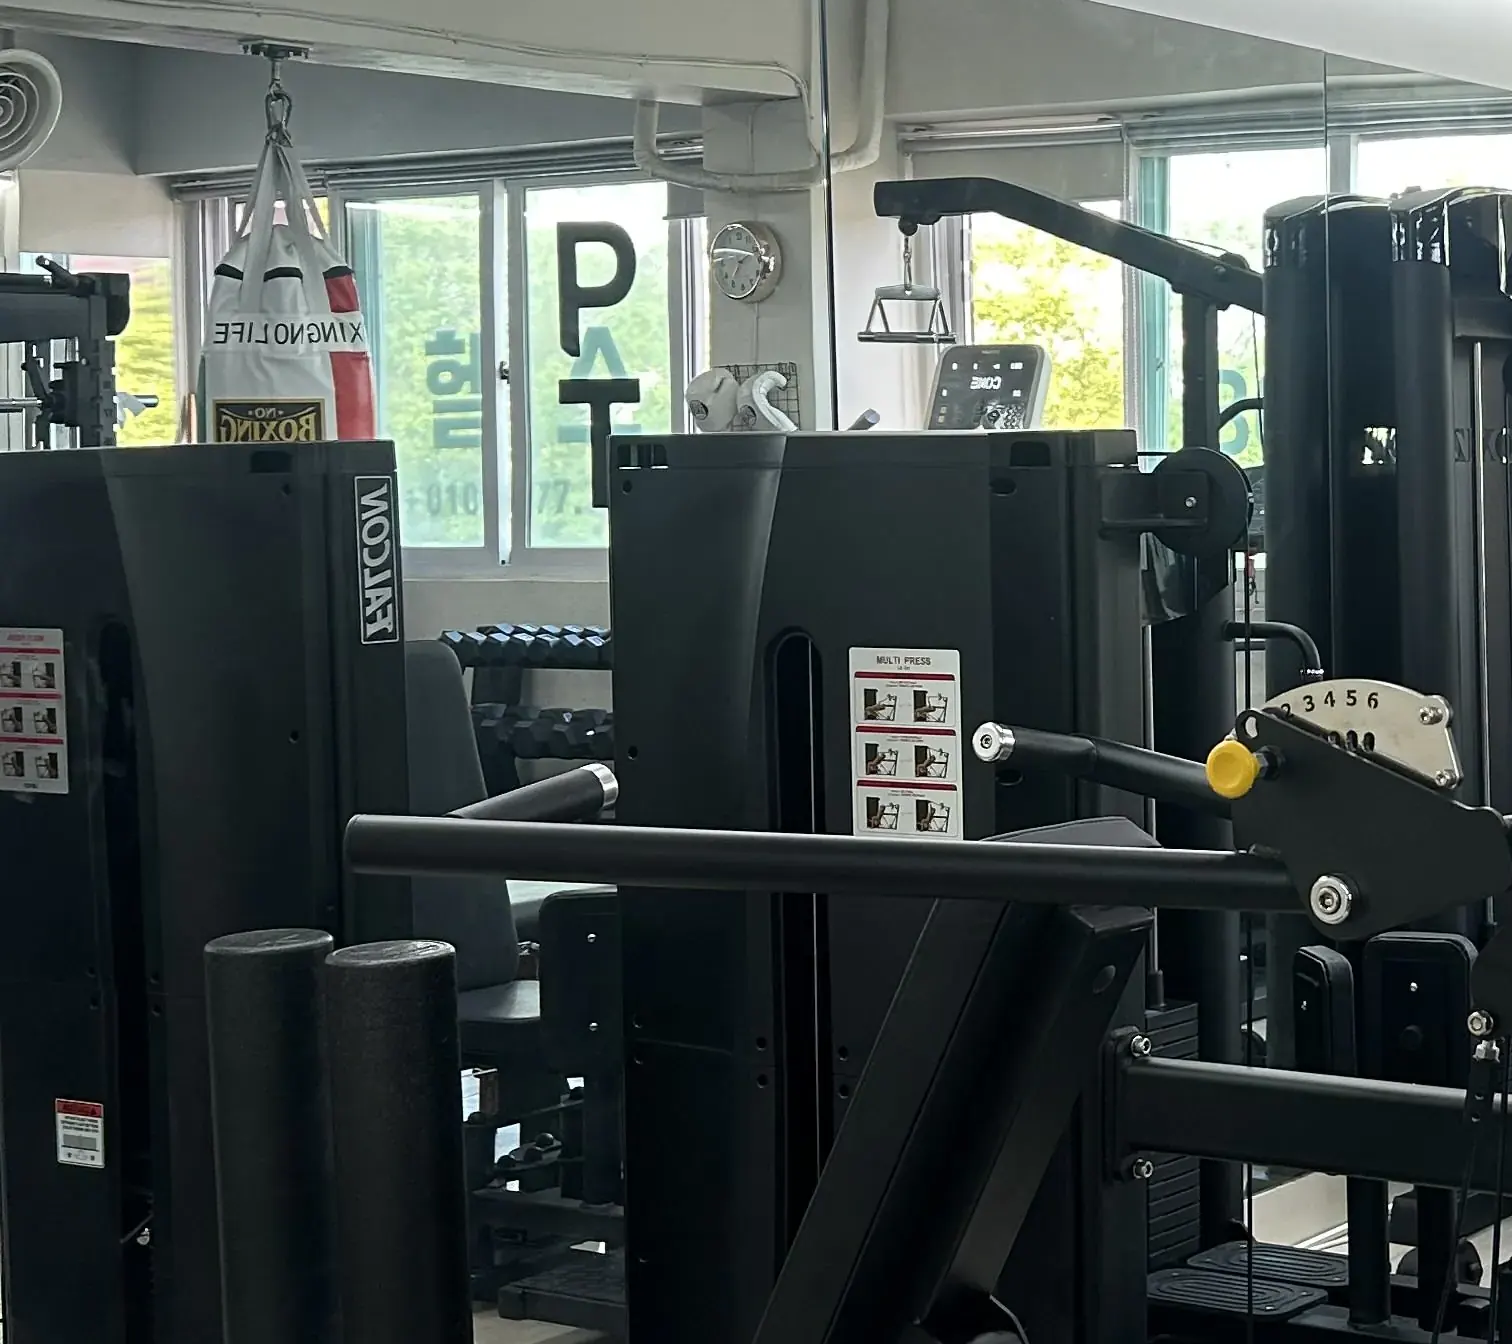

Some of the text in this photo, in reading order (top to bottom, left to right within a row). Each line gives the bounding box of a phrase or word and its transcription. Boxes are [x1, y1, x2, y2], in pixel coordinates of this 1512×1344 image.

[876, 655, 931, 666] MULTI PRESS
[1303, 695, 1315, 712] 3
[1324, 691, 1336, 708] 4
[1346, 690, 1357, 706] 5
[1367, 692, 1379, 709] 6
